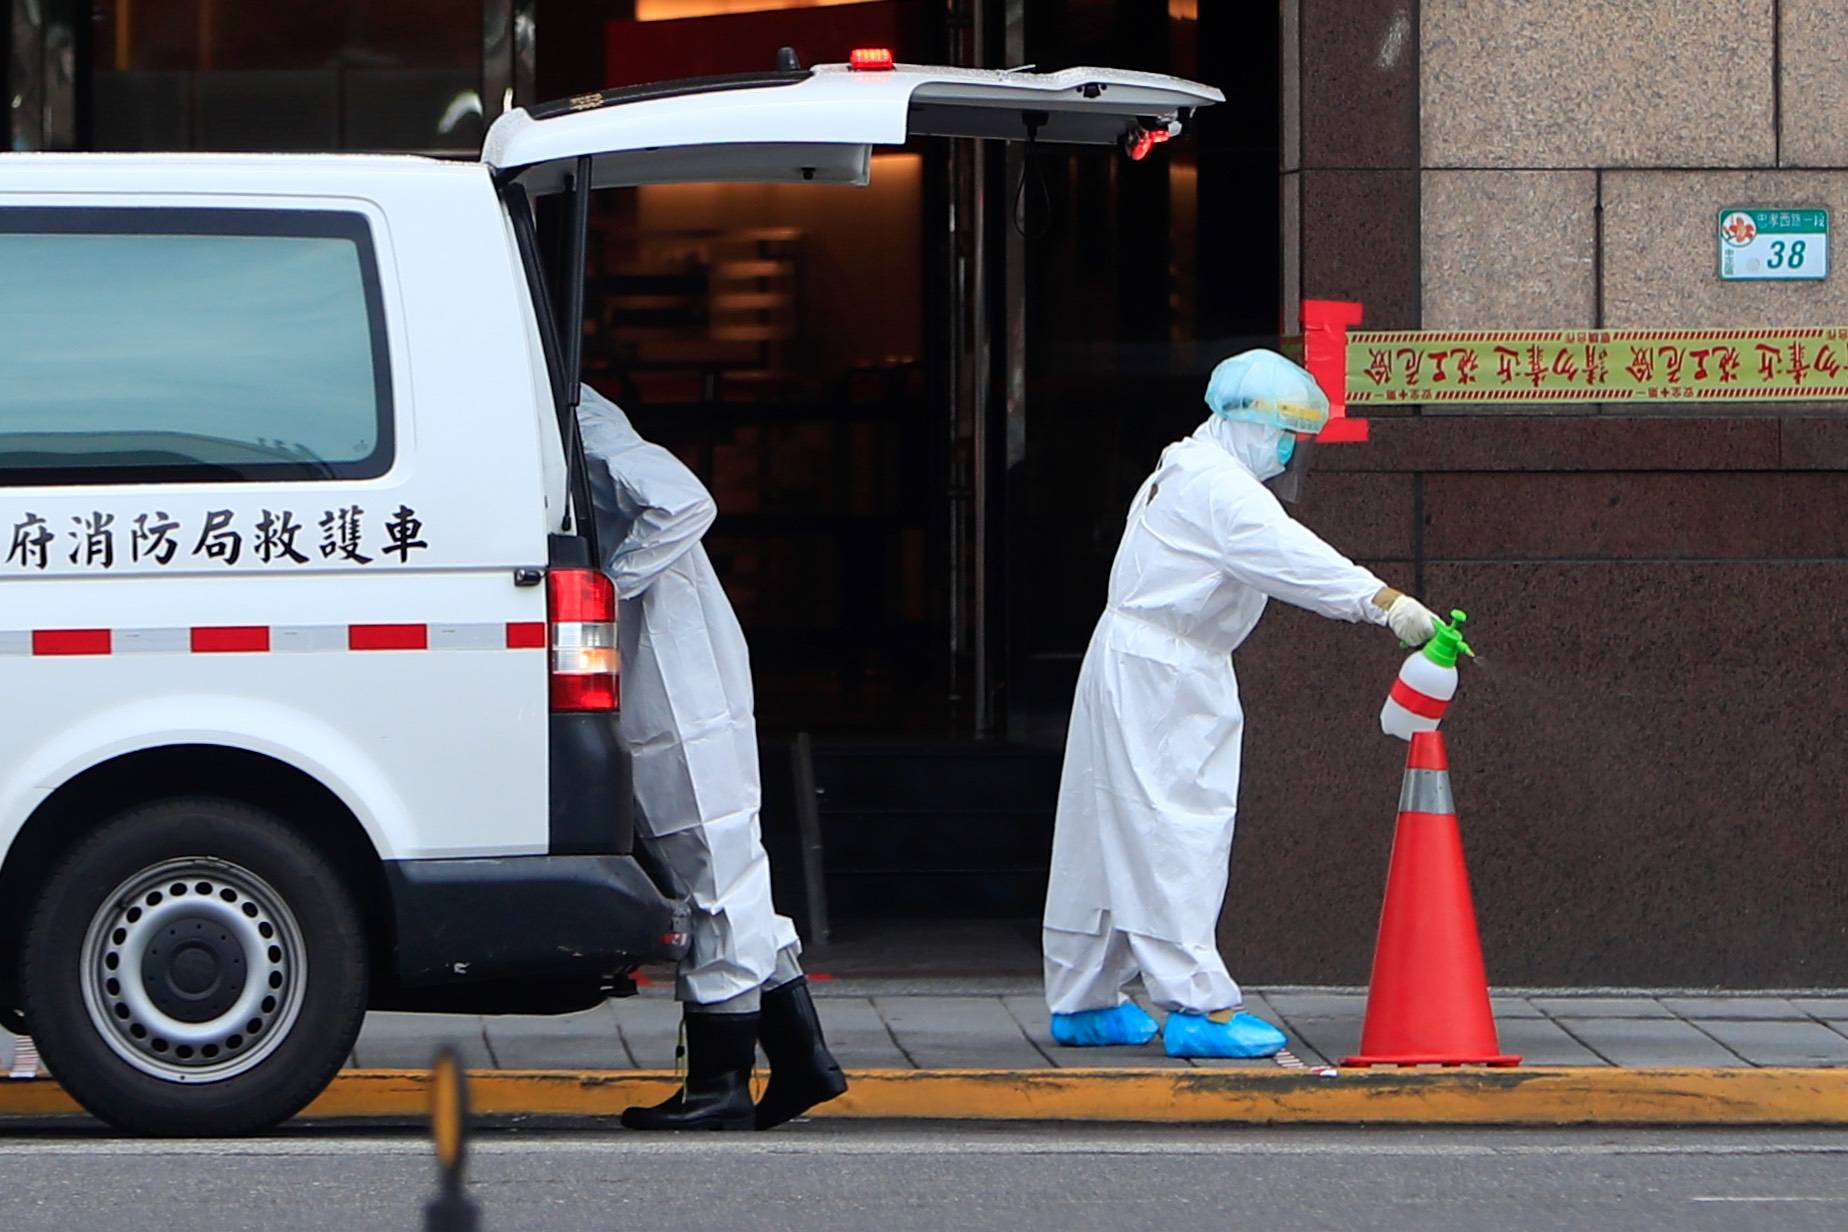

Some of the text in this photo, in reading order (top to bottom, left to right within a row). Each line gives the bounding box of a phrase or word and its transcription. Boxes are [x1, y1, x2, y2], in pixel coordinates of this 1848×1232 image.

[1767, 240, 1806, 269] 38
[1364, 347, 1479, 386] 施工危險
[1494, 344, 1609, 385] 請勿靠近
[1626, 345, 1741, 385] 施工危險
[6, 504, 428, 570] 府消防局救護車
